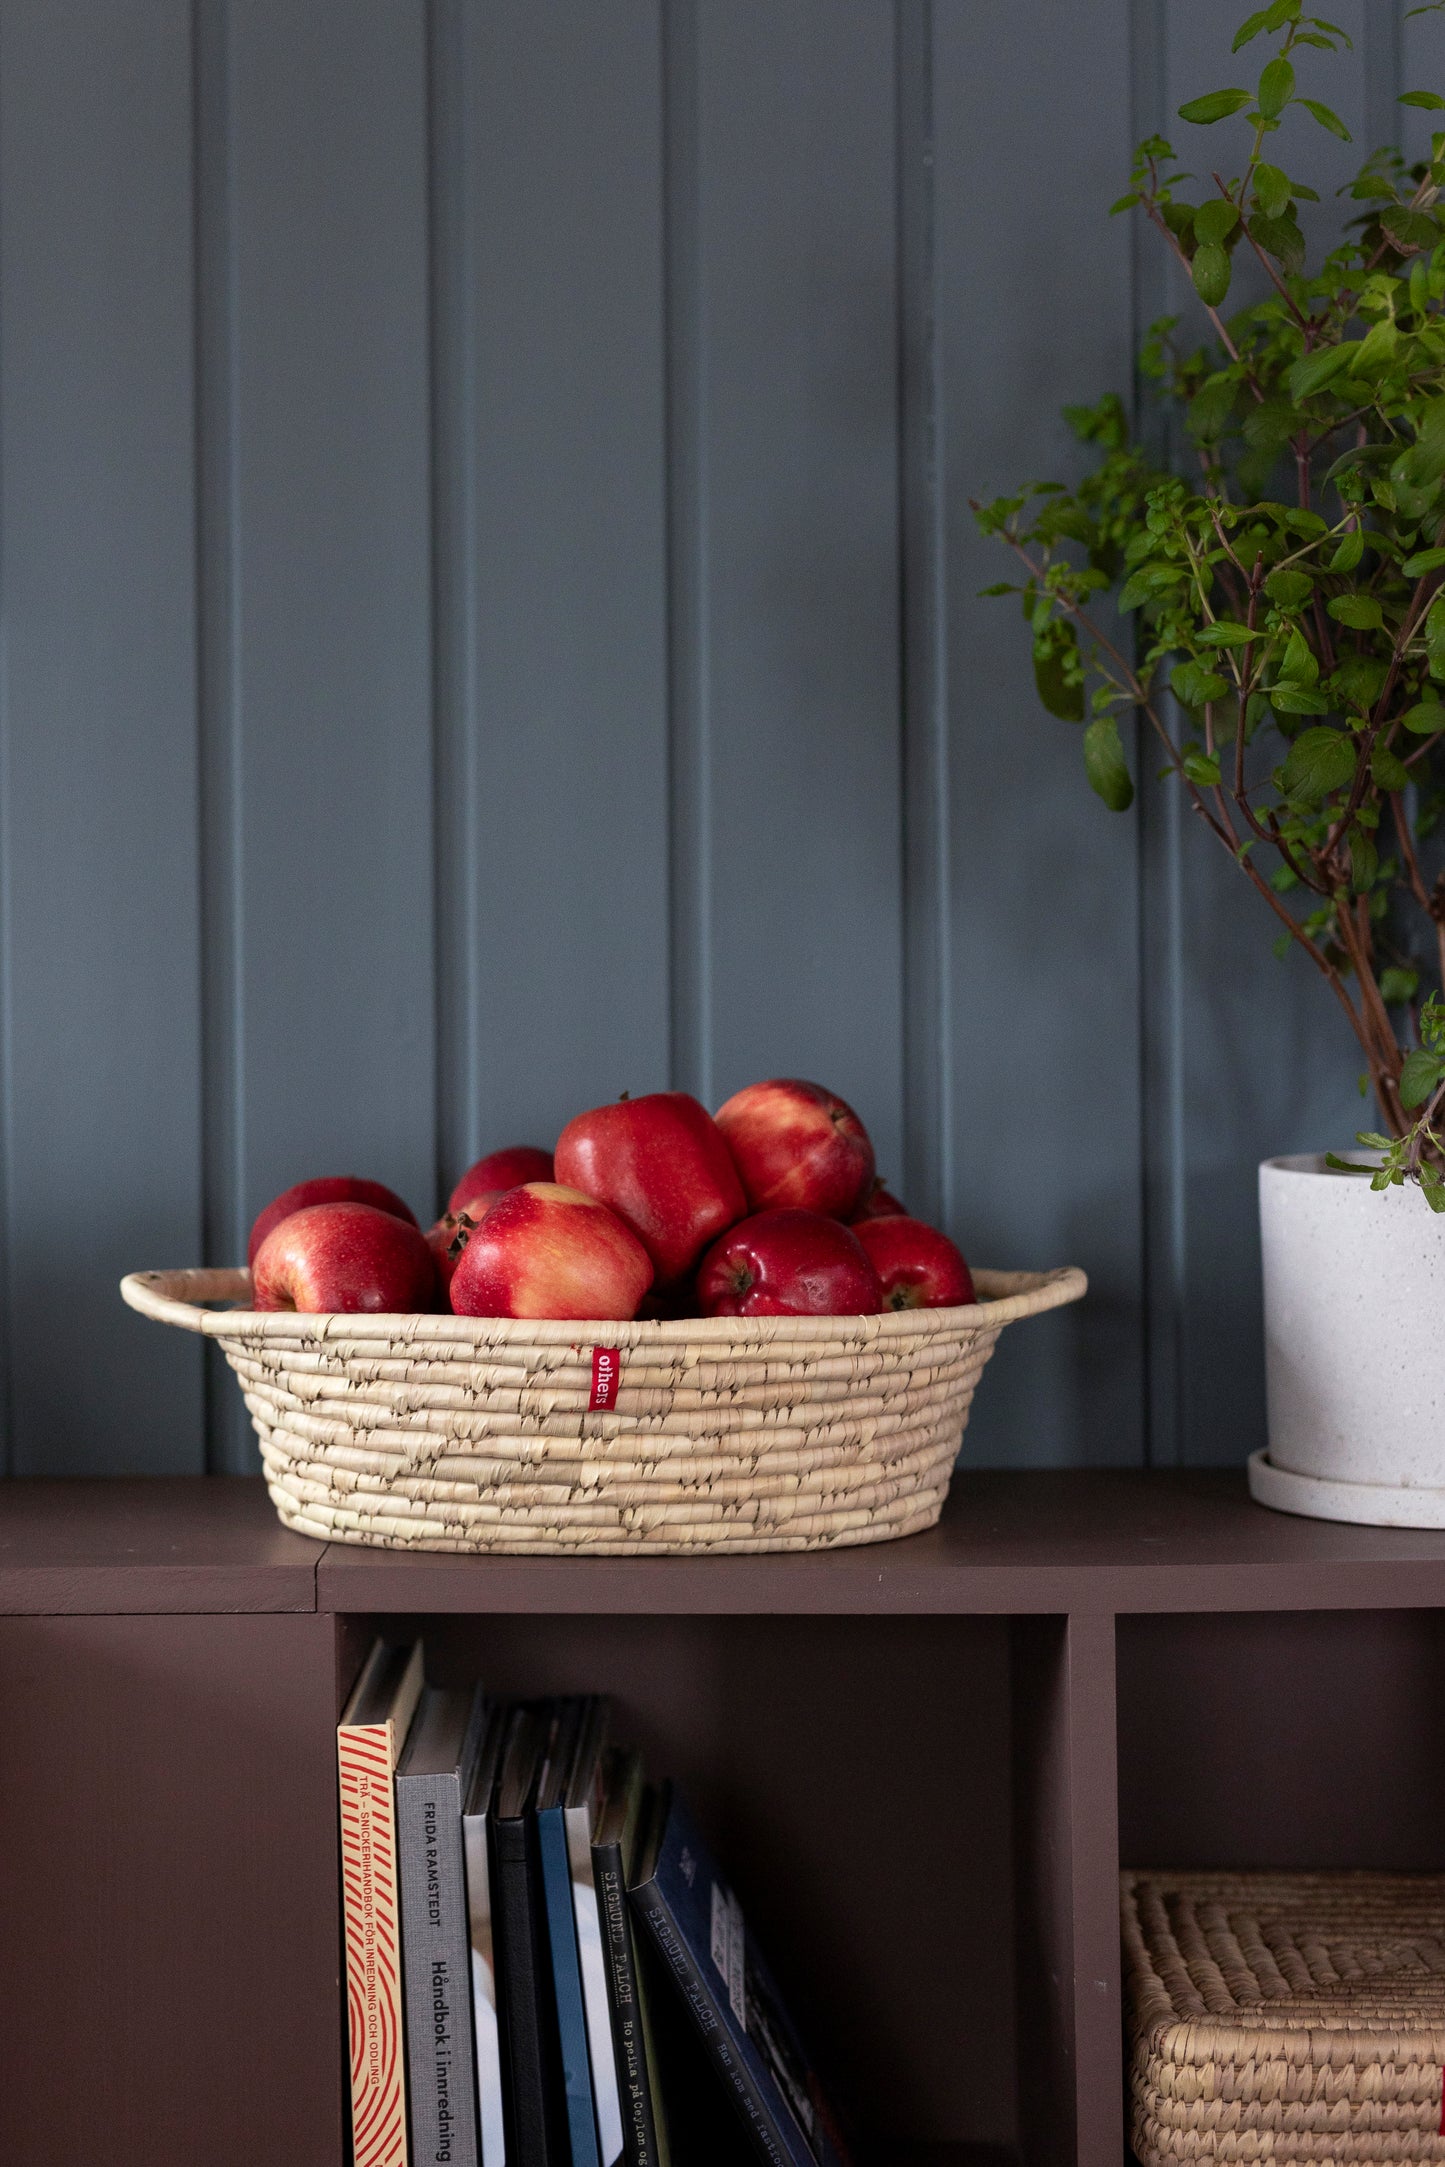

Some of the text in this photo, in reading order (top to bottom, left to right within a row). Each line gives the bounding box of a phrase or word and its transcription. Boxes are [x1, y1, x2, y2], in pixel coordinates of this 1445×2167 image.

[595, 1355, 613, 1404] others
[359, 1776, 371, 1798] TRÄ
[360, 1812, 373, 1918] SNICKERIHANDBOK
[424, 1802, 440, 1927] FRIDA RAMSTEDT
[365, 1923, 376, 1945] FÖR
[605, 1871, 632, 2004] SIGMUND FALCH
[366, 1948, 377, 2011] INREDNING
[649, 1906, 718, 2031] SIGMUND FALCH
[368, 2014, 378, 2039] OCH
[432, 1961, 452, 2046] Håndbok
[624, 2020, 633, 2036] Ho
[369, 2043, 380, 2085] ODLING
[624, 2041, 638, 2077] peika
[717, 2043, 733, 2066] Han
[744, 2097, 760, 2119] med
[435, 2061, 455, 2163] innredning
[629, 2084, 644, 2099] på
[633, 2102, 647, 2146] Ceylon
